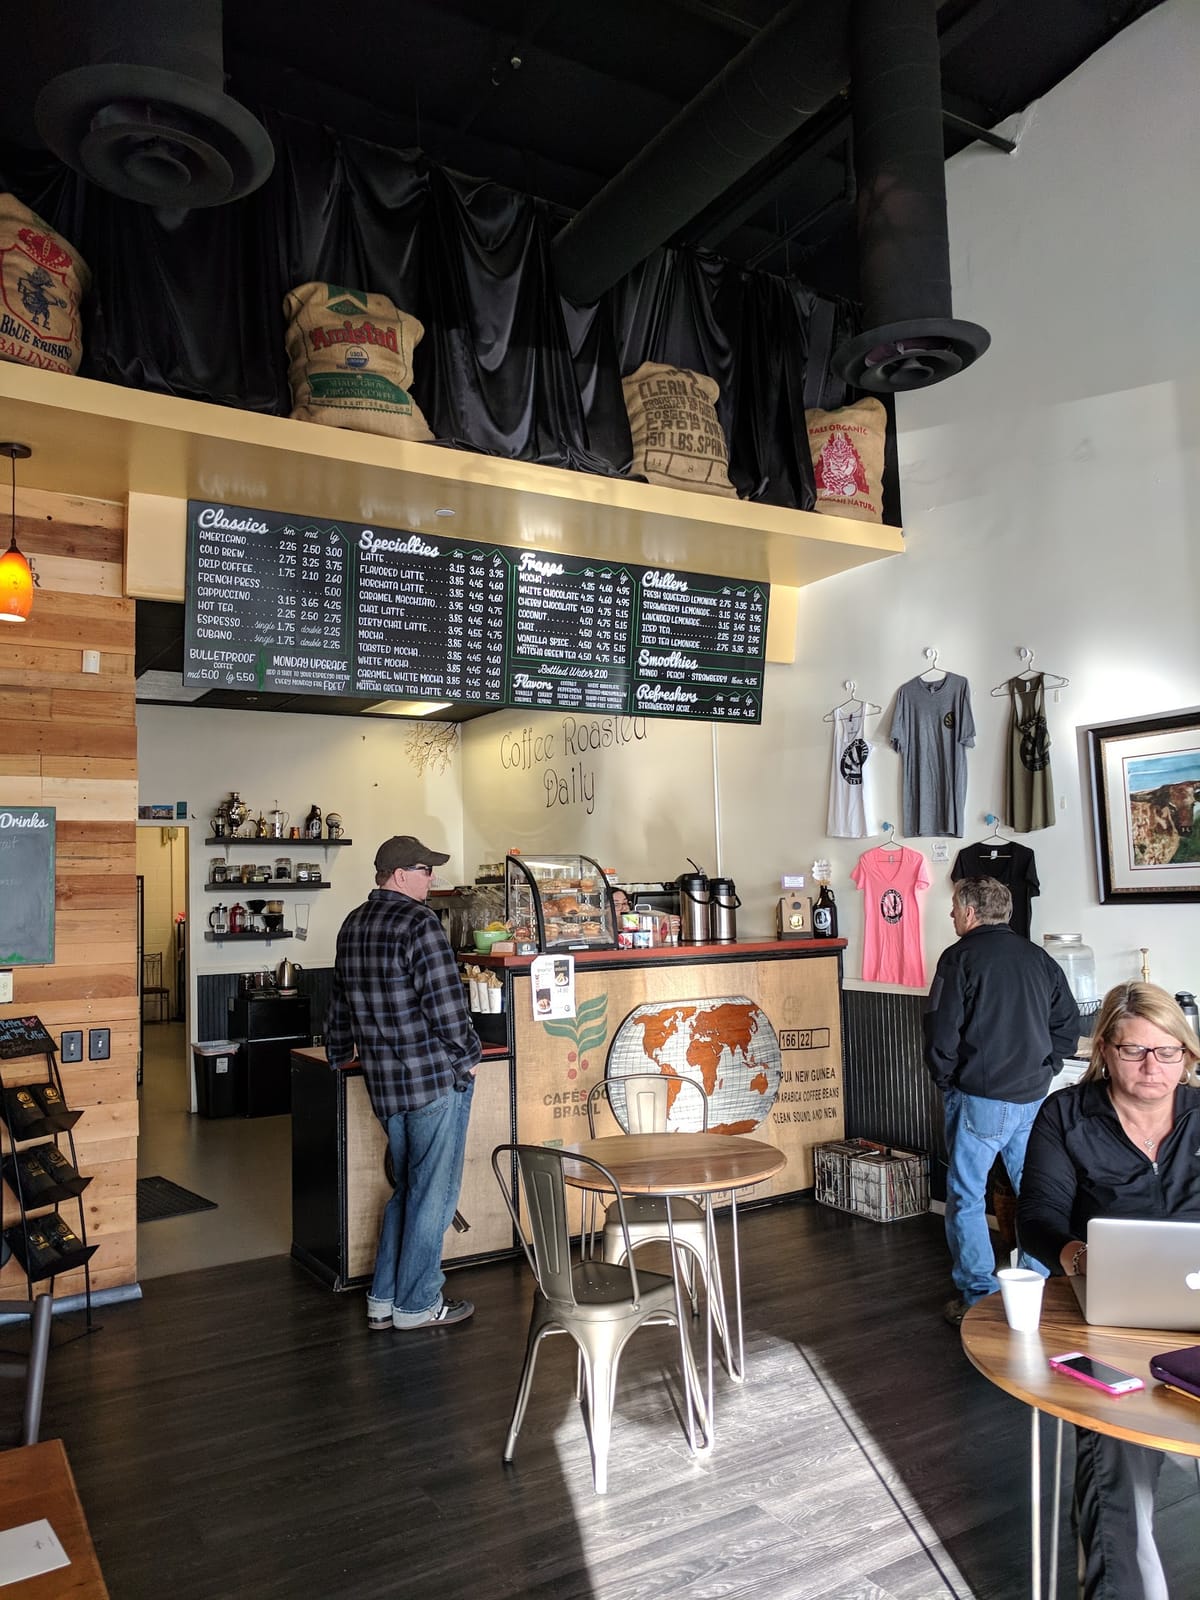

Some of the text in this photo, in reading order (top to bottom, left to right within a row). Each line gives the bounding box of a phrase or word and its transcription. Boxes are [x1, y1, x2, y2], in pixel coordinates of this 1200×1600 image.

[0, 314, 31, 343] BLUE
[309, 320, 399, 354] Amistad
[638, 380, 688, 400] CLEAN
[828, 424, 868, 436] ORGANIC
[645, 432, 666, 447] 150
[198, 508, 269, 535] Classics
[304, 530, 318, 538] md
[199, 531, 246, 544] AMERICANO
[326, 547, 342, 557] 3.00
[359, 530, 440, 558] Specialties
[199, 544, 219, 555] COLD
[222, 547, 244, 558] BREW
[302, 557, 319, 567] 3.25
[326, 560, 342, 570] 3.75
[361, 553, 384, 562] LATTE
[199, 558, 342, 584] DRIP COFFEE 1.75 2.10 2.60
[360, 565, 424, 580] FLAVORED LATTE
[519, 573, 542, 583] MOCHA
[198, 572, 341, 597] FRENCH PRESS 5.00
[360, 578, 424, 593] HORCHATA LATTE
[641, 571, 688, 592] Chillers
[198, 587, 341, 609] CAPPUCCINO 3.15 3.65 4.25
[359, 591, 436, 607] CARAMEL MACCHIATO
[519, 586, 579, 600] WHITE CHOCOLATE
[198, 601, 341, 623] HOT TEA 2.25 2.50 2.75
[359, 604, 405, 616] CHAI LATTE
[518, 598, 578, 612] CHERRY CHOCOLATE
[518, 609, 547, 620] COCONUT
[198, 614, 240, 627] ESPRESSO
[277, 623, 295, 632] 1.75
[324, 627, 340, 637] 2.25
[359, 617, 428, 632] DIRTY CHAI LATTE
[518, 622, 534, 631] CHAI
[642, 624, 658, 633] ICED
[197, 628, 232, 640] CUBANO
[276, 636, 295, 645] 1.75
[323, 640, 340, 649] 2.25
[359, 630, 384, 640] MOCHA
[517, 634, 547, 645] VANILLA
[550, 637, 569, 647] SPICE
[641, 635, 656, 644] ICED
[190, 649, 256, 663] BULLETPROOF
[358, 643, 418, 656] TOASTED MOCHA
[565, 650, 576, 659] TEA
[273, 656, 348, 670] MONDAY UPGRADE
[358, 656, 409, 668] WHITE MOCHA
[638, 650, 698, 670] Smoothies
[201, 670, 219, 679] 5.00
[236, 673, 254, 682] 5.50
[358, 669, 443, 684] CARAMEL WHITE MOCHA
[538, 664, 608, 679] Bottled Water 2.00
[324, 681, 345, 691] FREE!
[513, 674, 553, 689] Flavors
[405, 685, 418, 694] TEA
[420, 686, 441, 696] LATTE
[636, 684, 698, 703] Refreshers
[500, 716, 647, 770] Coffee Roasted
[543, 762, 595, 815] Daily
[0, 812, 49, 828] Drinks
[781, 1033, 810, 1047] 166 22
[795, 1068, 810, 1083] NEW
[811, 1067, 836, 1081] GUINEA
[543, 1088, 587, 1106] CAFÉS
[781, 1087, 839, 1102] ARABICA COFFEE BEANS
[553, 1103, 601, 1119] BRASL
[773, 1107, 837, 1124] CLEAN SOUND AND NEW
